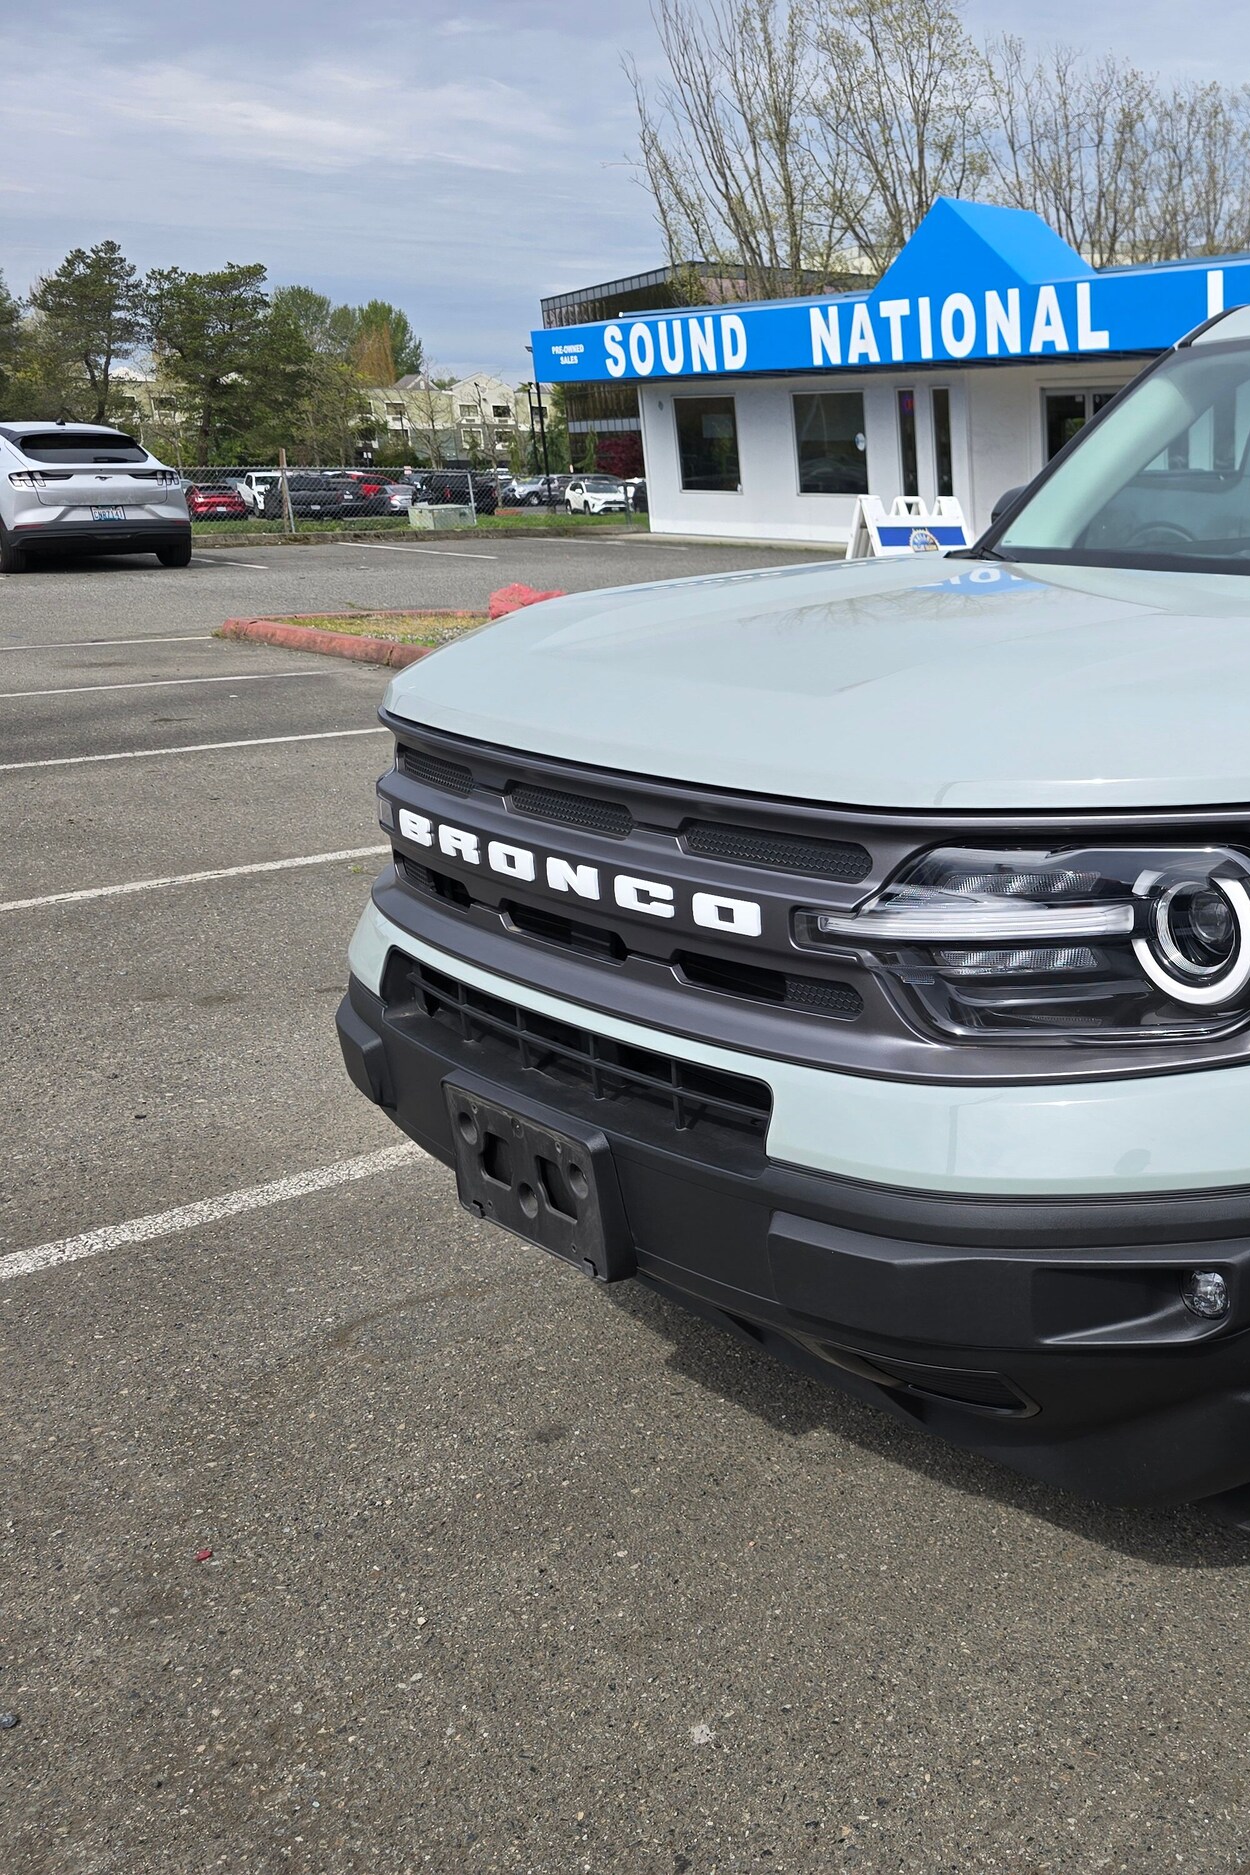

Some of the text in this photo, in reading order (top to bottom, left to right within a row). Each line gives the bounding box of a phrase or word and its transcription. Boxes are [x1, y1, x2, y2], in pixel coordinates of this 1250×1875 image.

[551, 344, 584, 355] PRE-OWNED
[603, 314, 747, 378] SOUND
[809, 283, 1110, 366] NATIONAL
[560, 355, 579, 364] SALES
[399, 808, 762, 937] BRONCO
